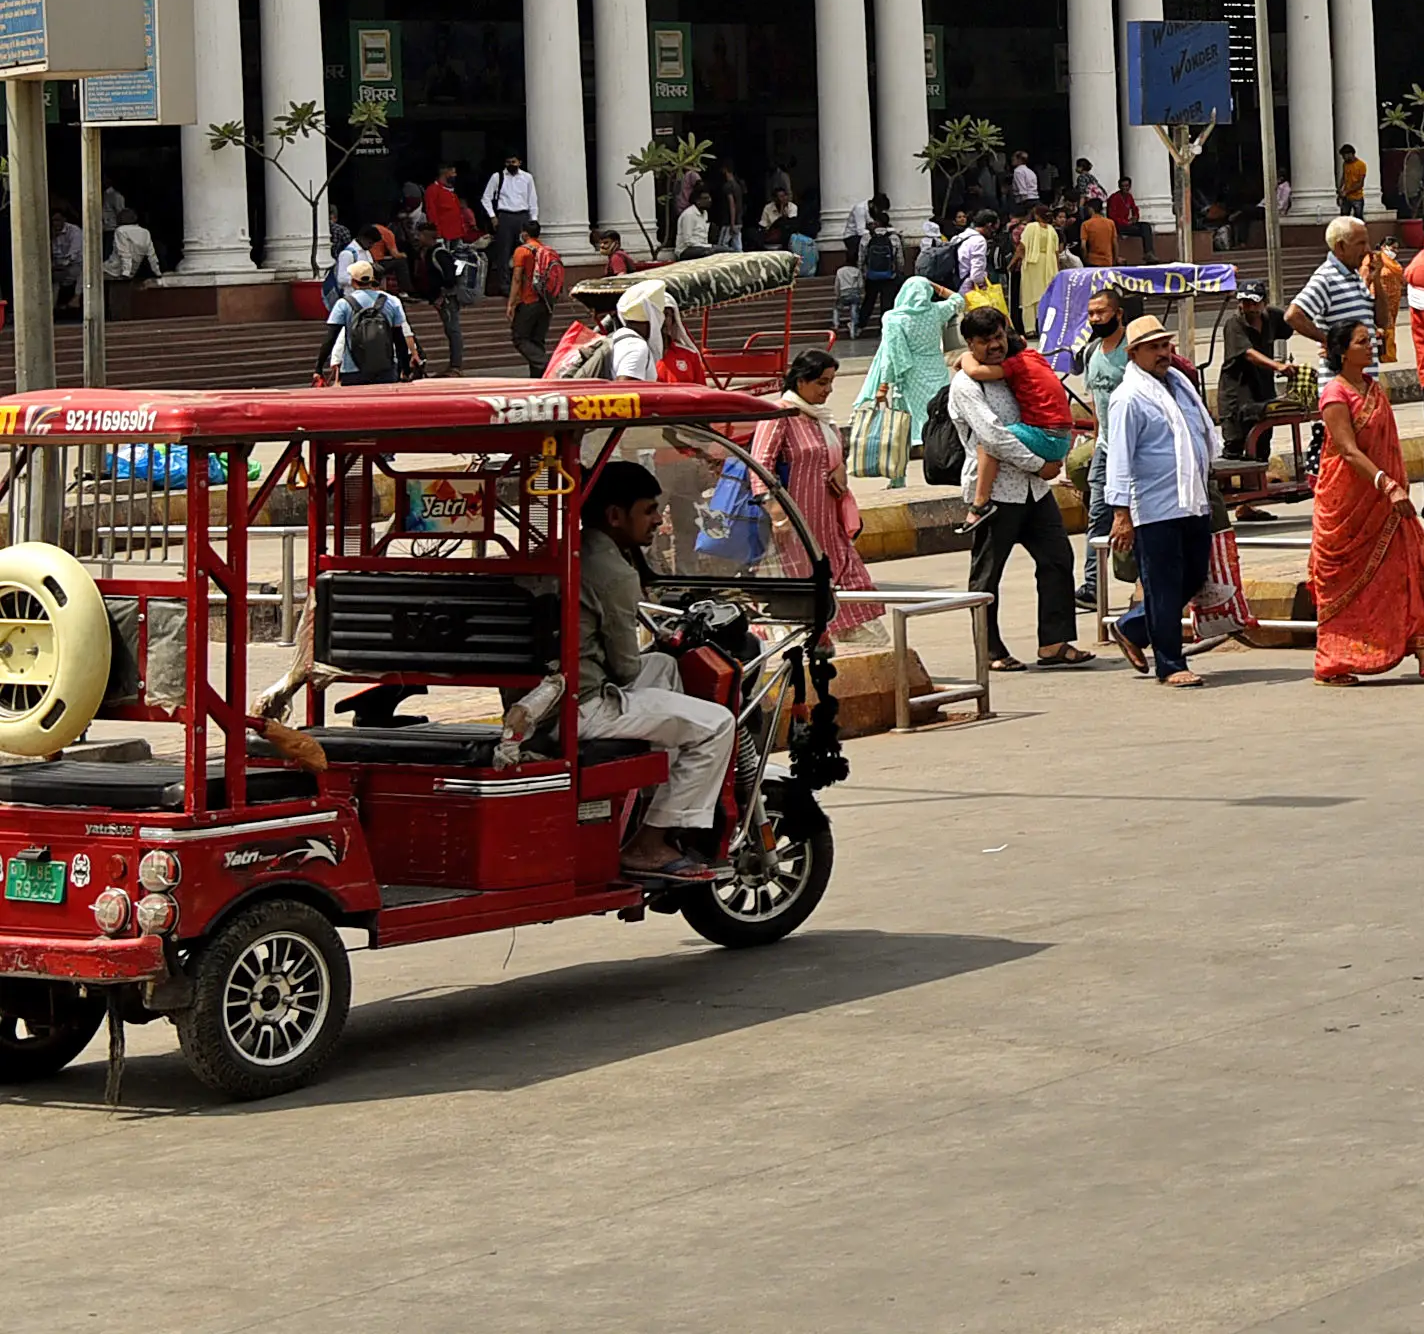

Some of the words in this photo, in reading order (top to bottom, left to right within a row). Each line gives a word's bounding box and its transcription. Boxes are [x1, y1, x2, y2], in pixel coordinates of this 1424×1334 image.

[1170, 44, 1219, 85] WONDER
[359, 84, 398, 102] शिखर
[655, 81, 689, 98] शिखर
[65, 409, 157, 431] 9211696901
[422, 496, 467, 517] Yatri
[224, 851, 259, 868] Yatri
